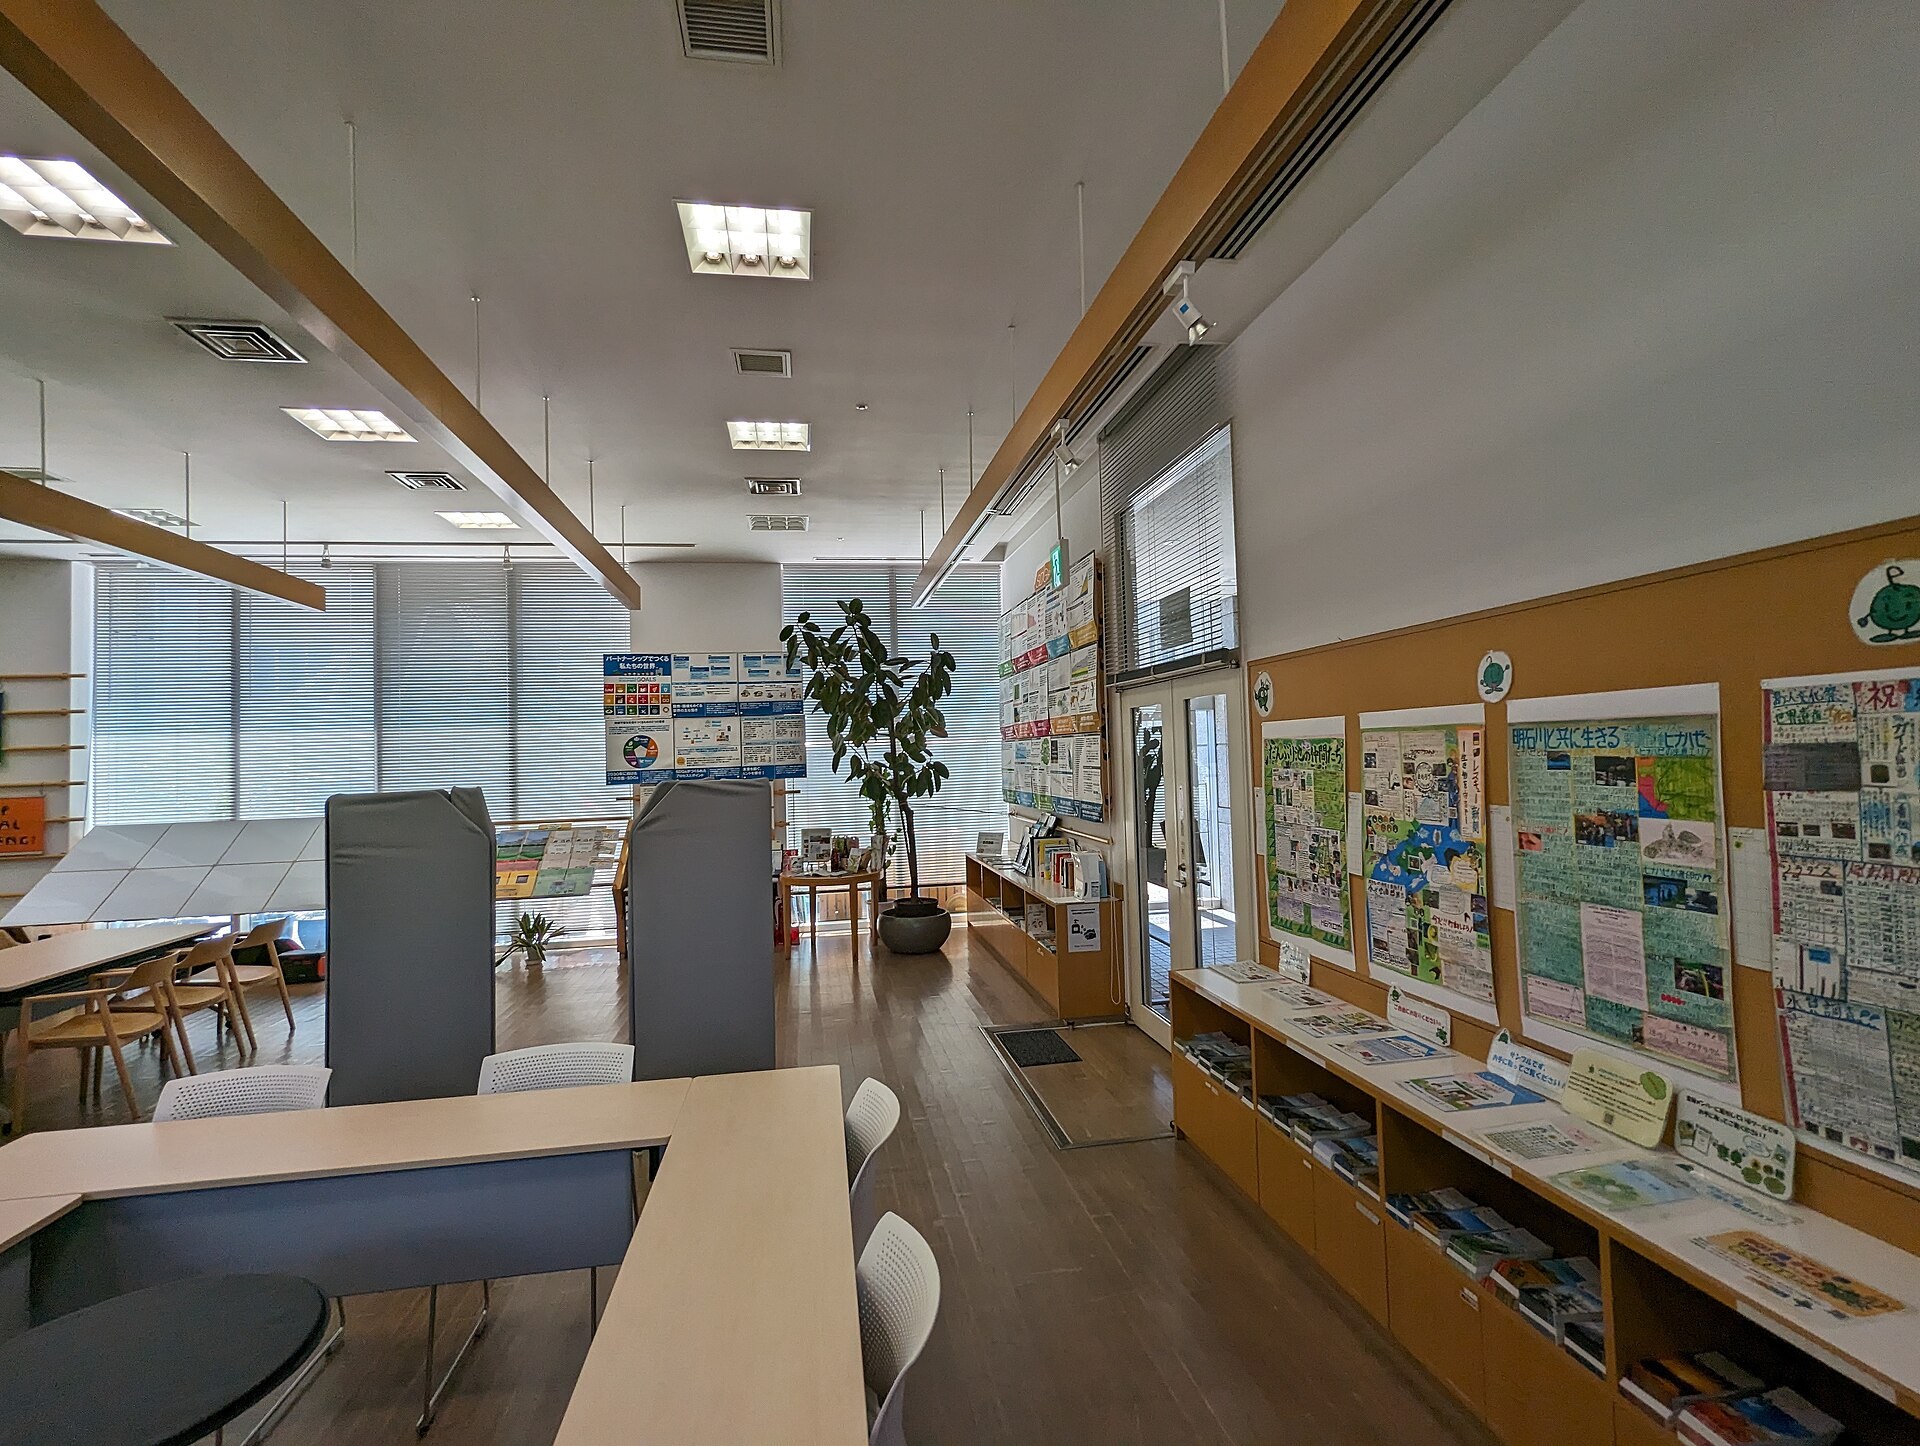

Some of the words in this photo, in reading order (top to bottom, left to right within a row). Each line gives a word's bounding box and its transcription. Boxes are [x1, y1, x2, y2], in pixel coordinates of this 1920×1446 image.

[605, 655, 670, 663] パートナーシップでつくる
[1865, 682, 1898, 711] 祝
[1512, 726, 1620, 752] 明石川と共に生きる
